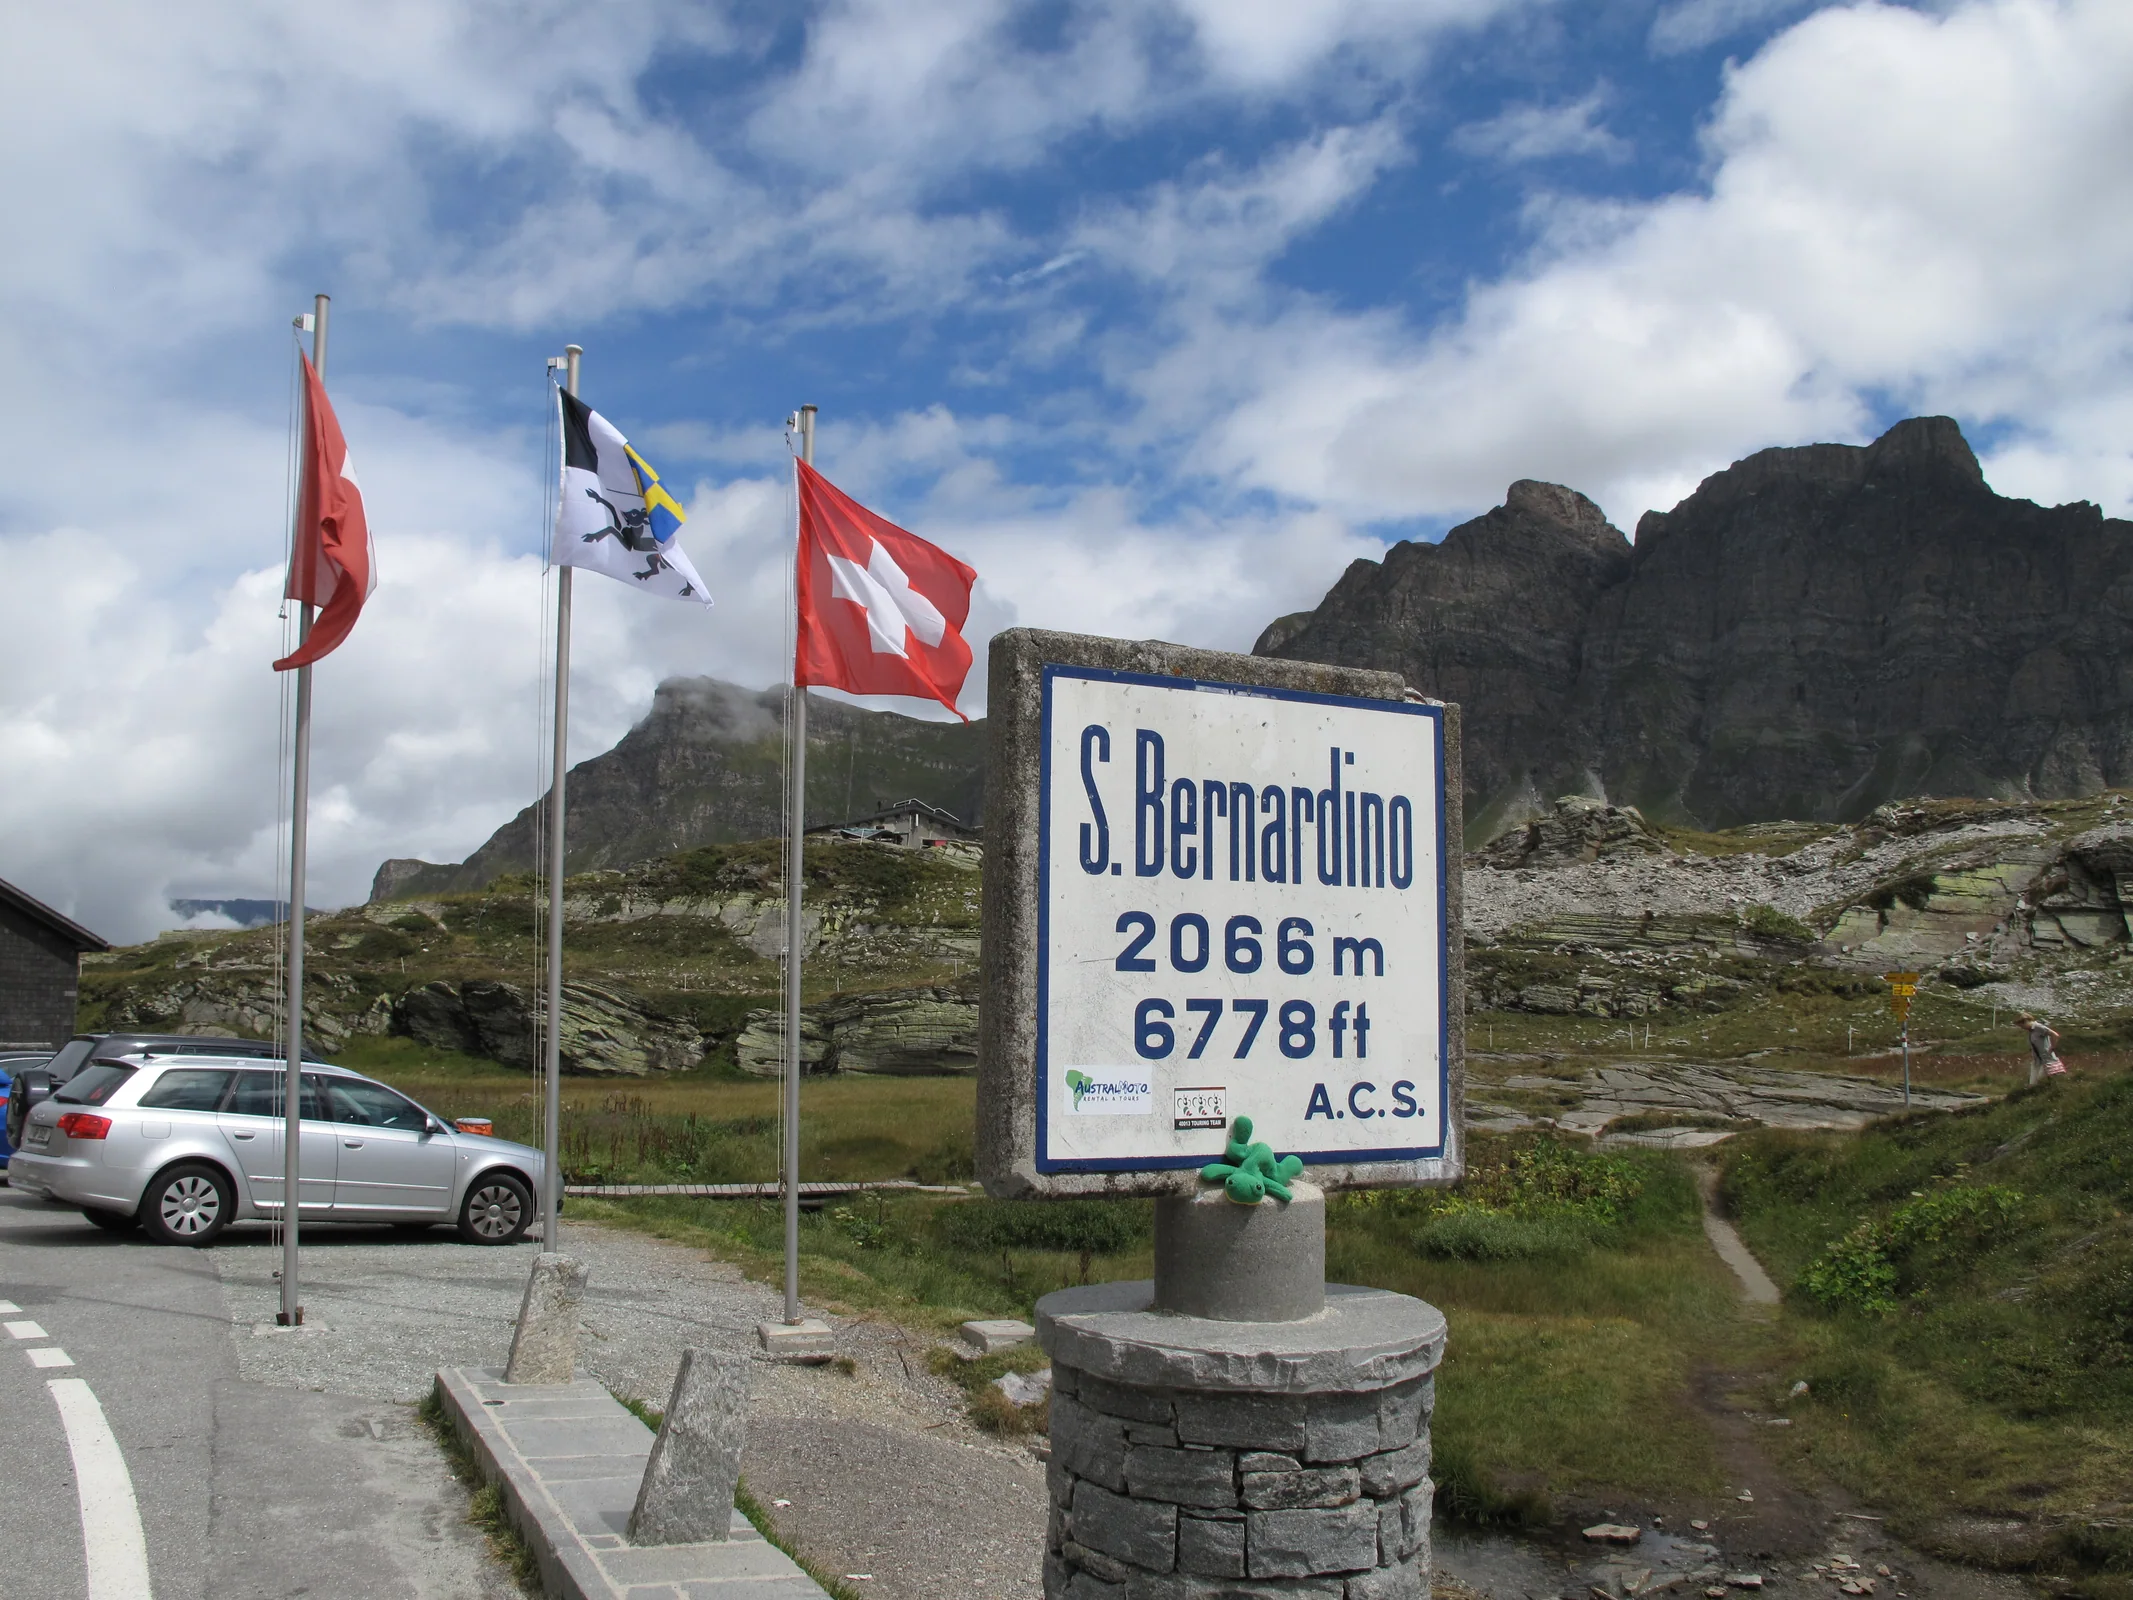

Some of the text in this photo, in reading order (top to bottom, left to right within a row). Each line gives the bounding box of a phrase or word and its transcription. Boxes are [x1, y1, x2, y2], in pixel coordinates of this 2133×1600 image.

[1080, 725, 1413, 889] S. Bernardino
[1117, 912, 1314, 974] 2066
[1305, 1081, 1426, 1119] A.C.S.
